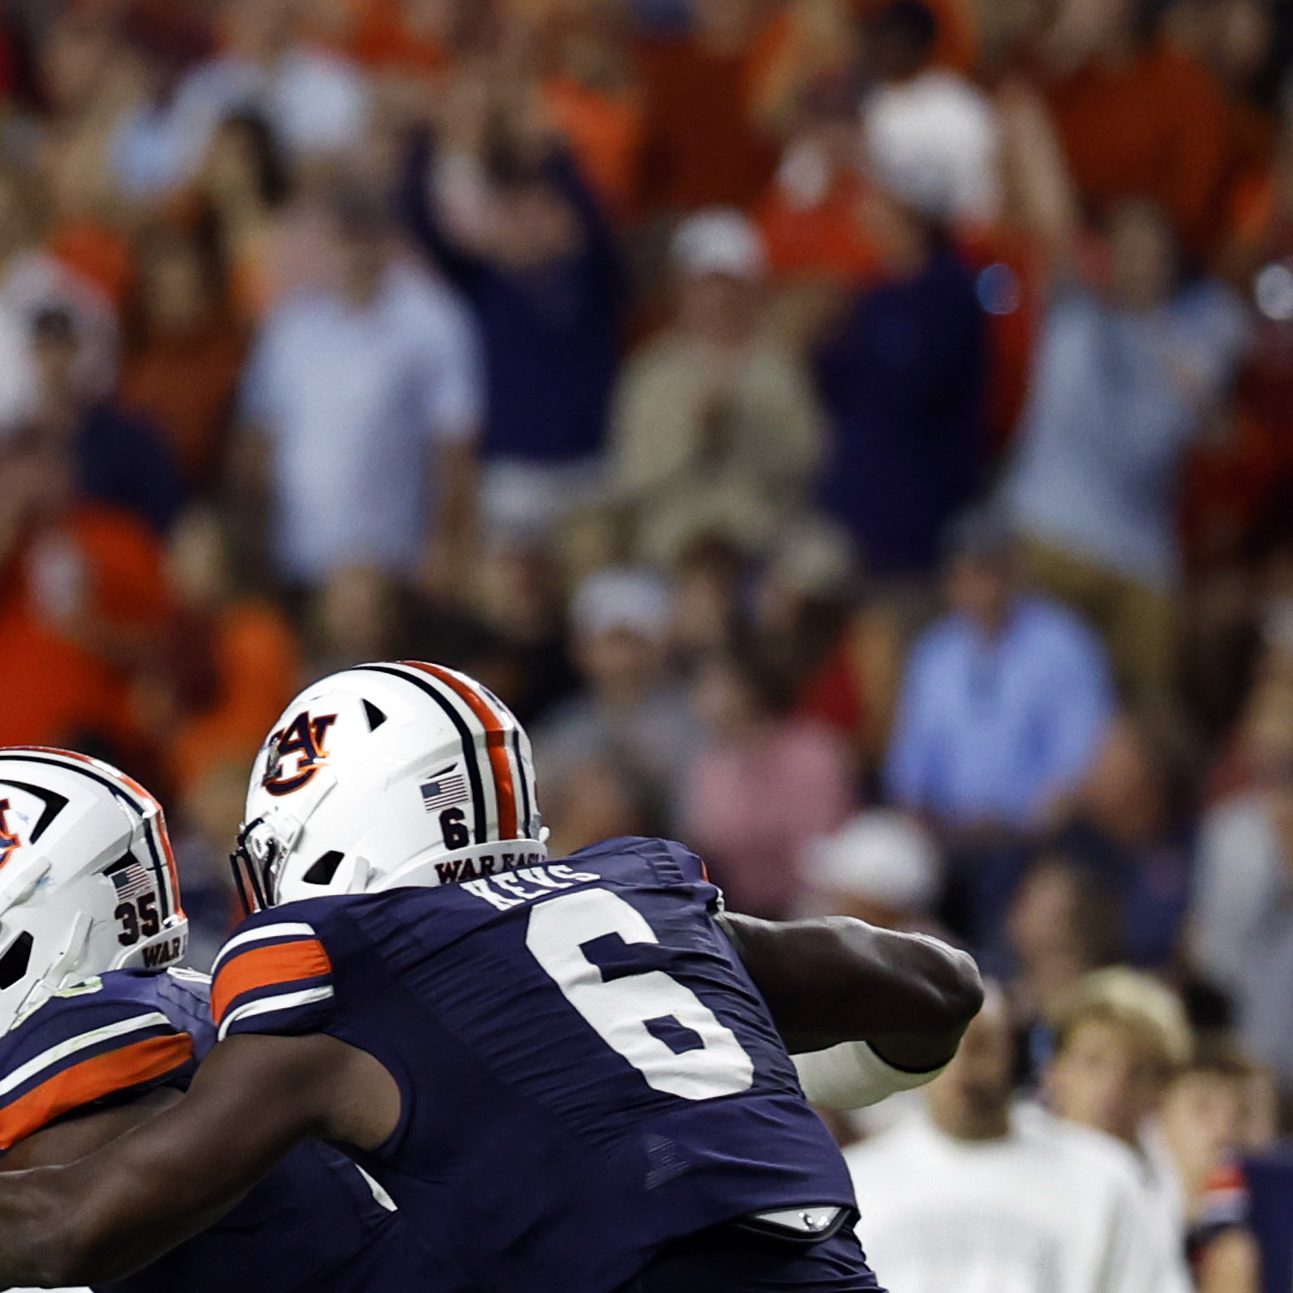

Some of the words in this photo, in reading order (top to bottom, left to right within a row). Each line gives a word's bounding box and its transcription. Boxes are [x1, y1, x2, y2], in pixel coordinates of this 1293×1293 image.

[439, 807, 470, 850] 6
[434, 854, 495, 884] WAR
[114, 891, 160, 947] 35
[142, 936, 181, 969] WAR
[525, 887, 754, 1101] 6
